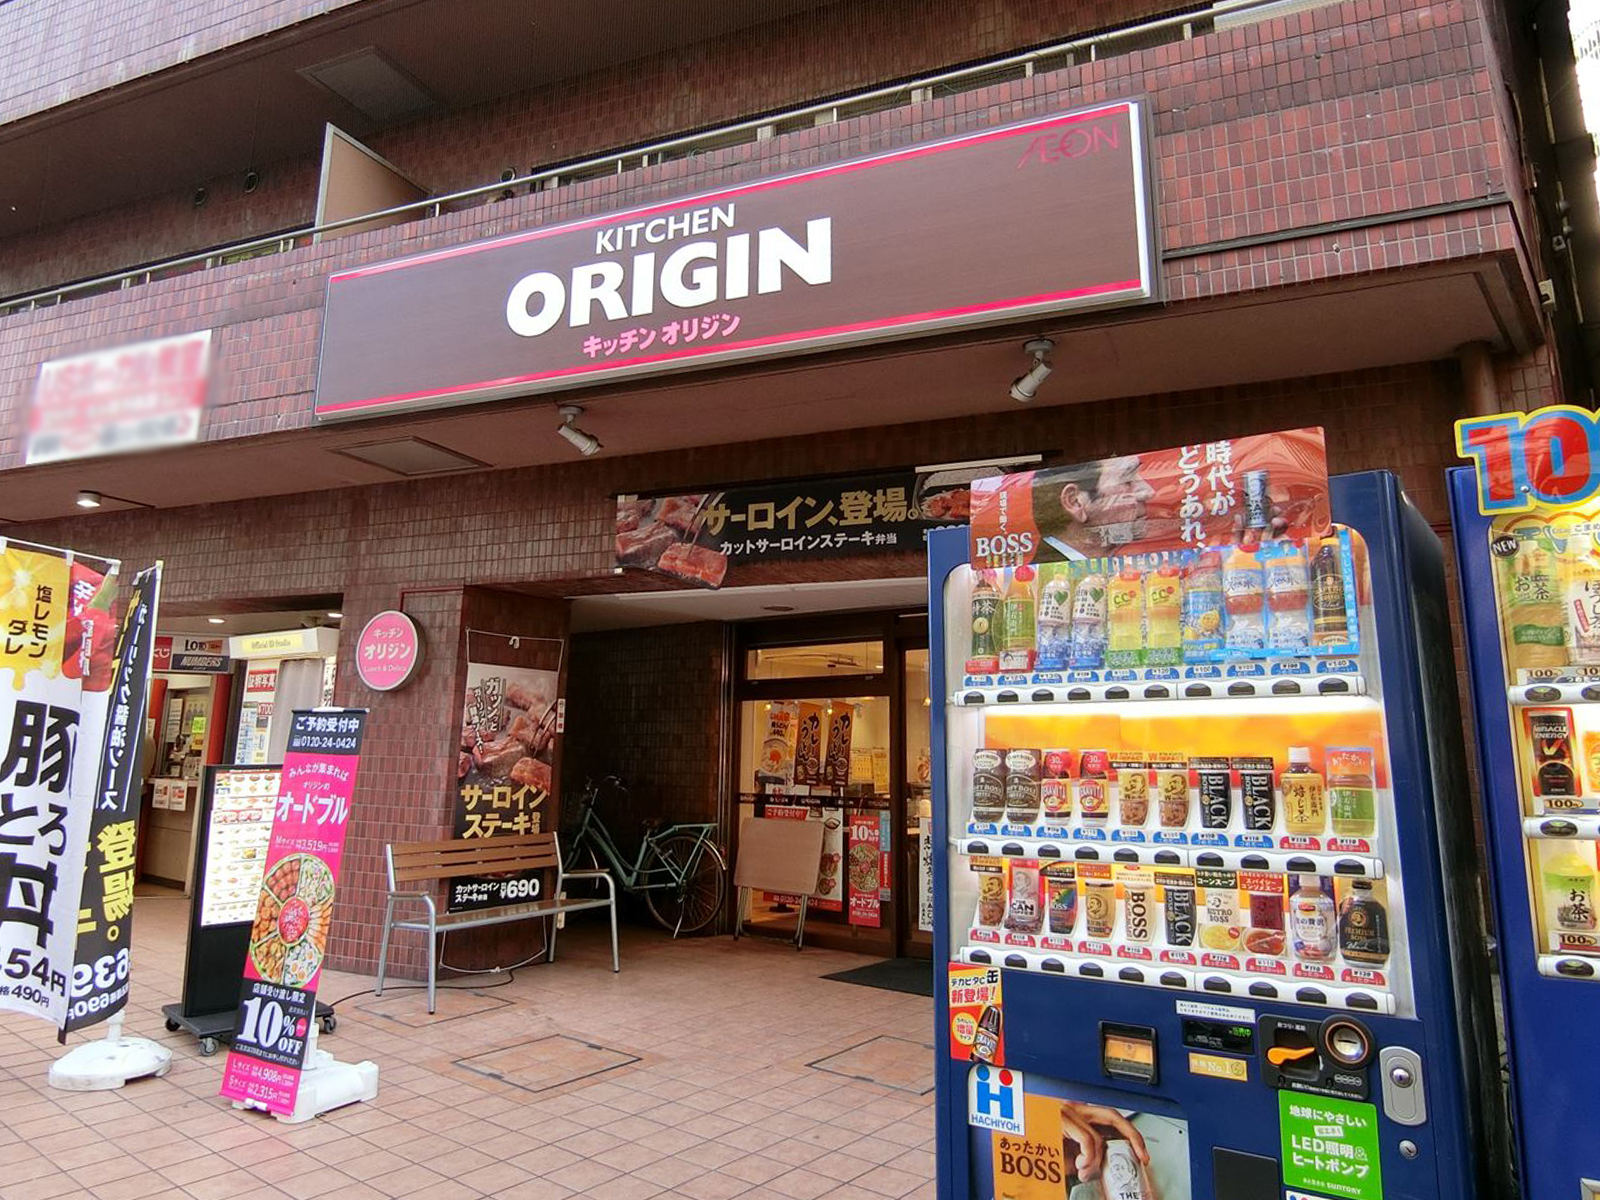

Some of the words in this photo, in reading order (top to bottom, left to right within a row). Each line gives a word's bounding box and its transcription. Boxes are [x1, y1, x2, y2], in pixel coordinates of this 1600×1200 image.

[594, 203, 737, 256] KITCHEN
[506, 217, 833, 337] ORIGIN
[583, 327, 656, 358] キッチン
[661, 314, 741, 345] オリジン
[1205, 441, 1235, 516] 時代が
[704, 487, 919, 536] サーロイン、登場。
[720, 532, 898, 556] カットサーロインステーキ弁当
[976, 532, 1033, 557] BOSS
[1492, 539, 1517, 555] NEW
[373, 628, 403, 639] キッチン
[364, 643, 411, 660] オリジン
[296, 716, 359, 733] ご予約受付中
[301, 735, 357, 749] 0120-24-0424
[276, 791, 348, 825] オードブル
[460, 783, 550, 811] サーロイン
[1207, 775, 1228, 828] BLACK
[1251, 775, 1272, 829] BLACK
[1131, 891, 1149, 939] BOSS
[1173, 889, 1192, 944] BLACK
[1570, 888, 1589, 921] お茶
[0, 947, 67, 997] 54円
[951, 986, 996, 1005] 新登場!
[278, 1036, 303, 1056] OFF
[971, 1113, 1021, 1132] HACHIYOH
[1289, 1104, 1367, 1128] 地球にやさしい
[999, 1136, 1060, 1158] あったかい
[1000, 1151, 1062, 1184] BOSS
[1292, 1152, 1370, 1178] ヒートポンプ
